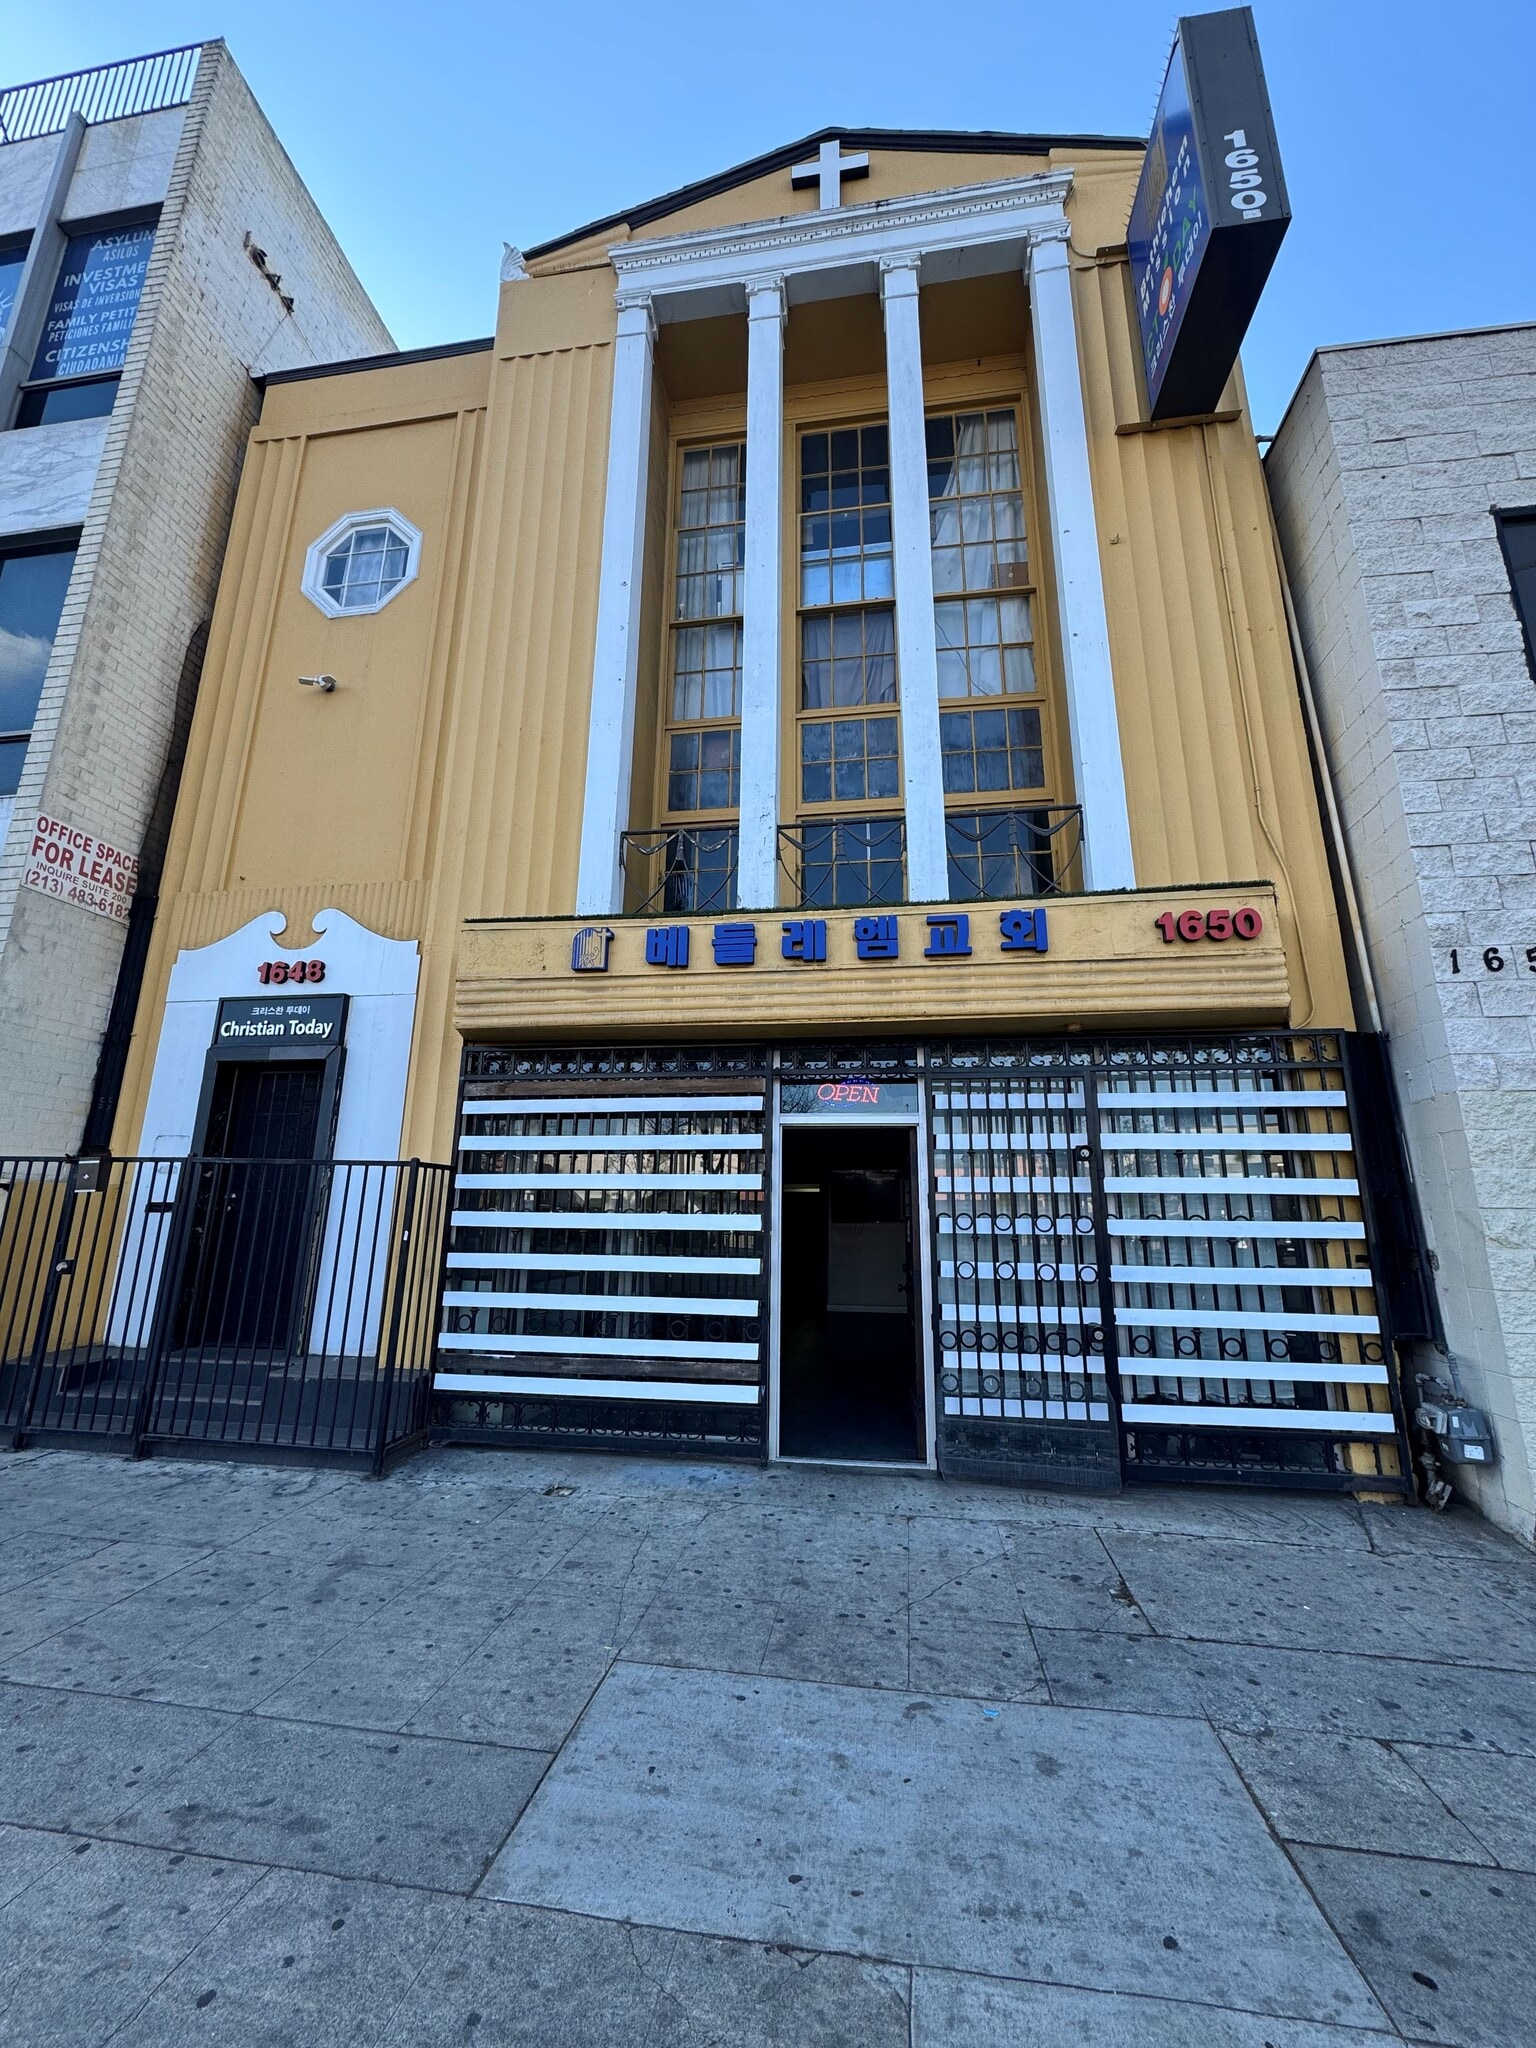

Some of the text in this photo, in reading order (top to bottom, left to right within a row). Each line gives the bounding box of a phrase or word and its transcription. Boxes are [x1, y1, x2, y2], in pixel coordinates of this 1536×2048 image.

[1223, 129, 1267, 211] 1650
[1140, 134, 1187, 300] Bethlehem
[90, 229, 156, 251] ASYLUM
[1143, 156, 1190, 319] Mission
[102, 245, 140, 262] ASILOS
[89, 275, 139, 294] VISAS
[54, 300, 80, 314] VISAS
[81, 297, 94, 309] DE
[47, 306, 138, 331] FAMILY PETIT
[48, 324, 100, 342] PETICIONES
[37, 816, 140, 874] OFFICE SPACE
[31, 835, 138, 897] FOR LEASE
[24, 869, 64, 896] (213)
[36, 861, 127, 905] INQUIRE SUITE 200
[1155, 907, 1263, 943] 1650
[257, 960, 326, 984] 1648
[285, 1005, 310, 1015] 투데이
[220, 1018, 333, 1038] Christian Today
[818, 1083, 880, 1103] OPEN
